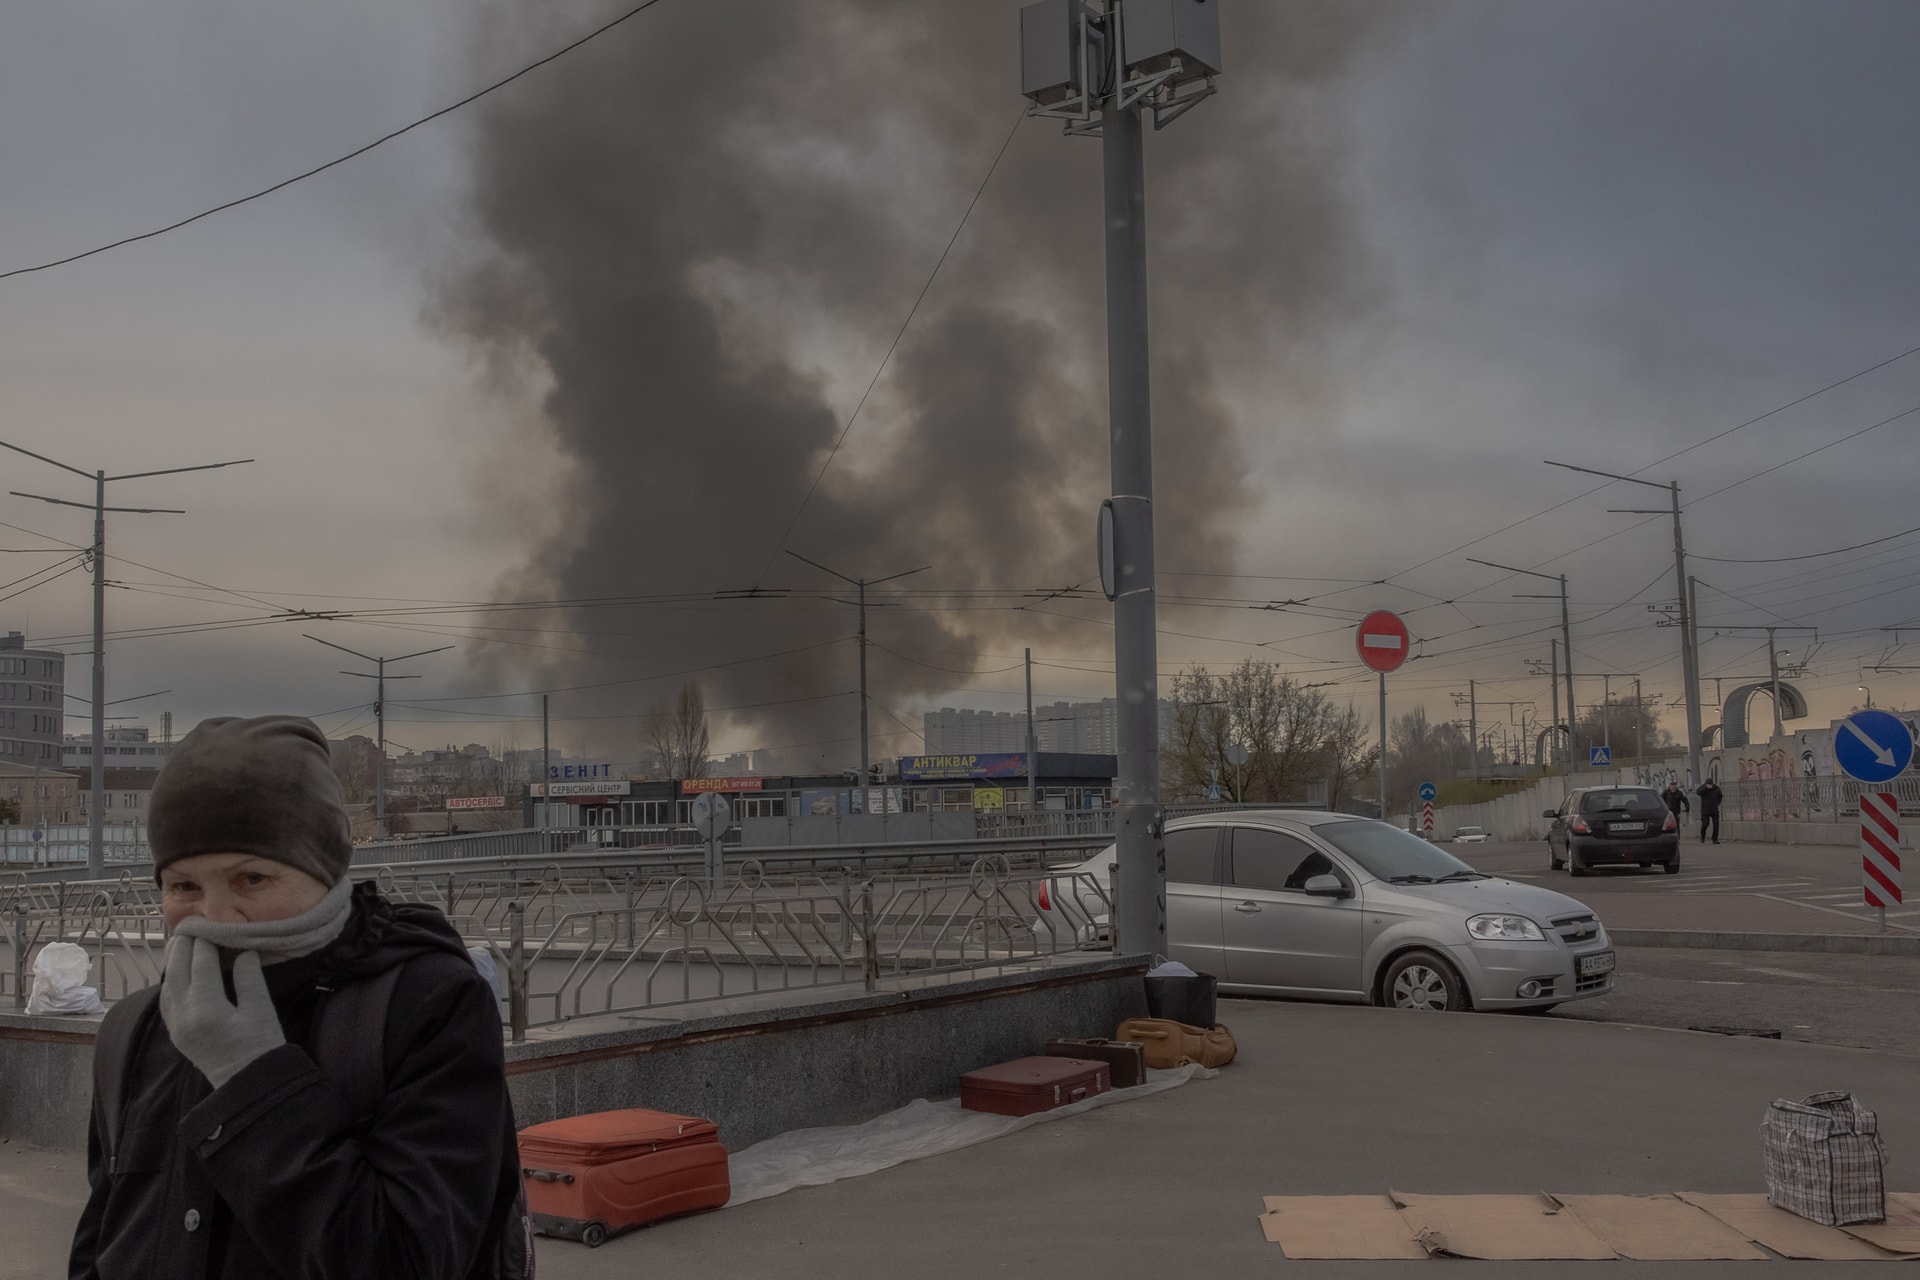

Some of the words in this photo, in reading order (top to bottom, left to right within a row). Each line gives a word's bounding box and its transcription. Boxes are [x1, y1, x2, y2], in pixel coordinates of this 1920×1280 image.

[913, 755, 977, 768] АНТИКВАР
[550, 763, 611, 778] ЗЕНІТ
[551, 783, 595, 795] СЕРВІСНИЙ
[597, 784, 622, 795] ЦЕНТР
[683, 779, 729, 790] ОРЕНДА
[449, 798, 502, 808] АВТОСЕРВІС
[1585, 959, 1594, 972] AA
